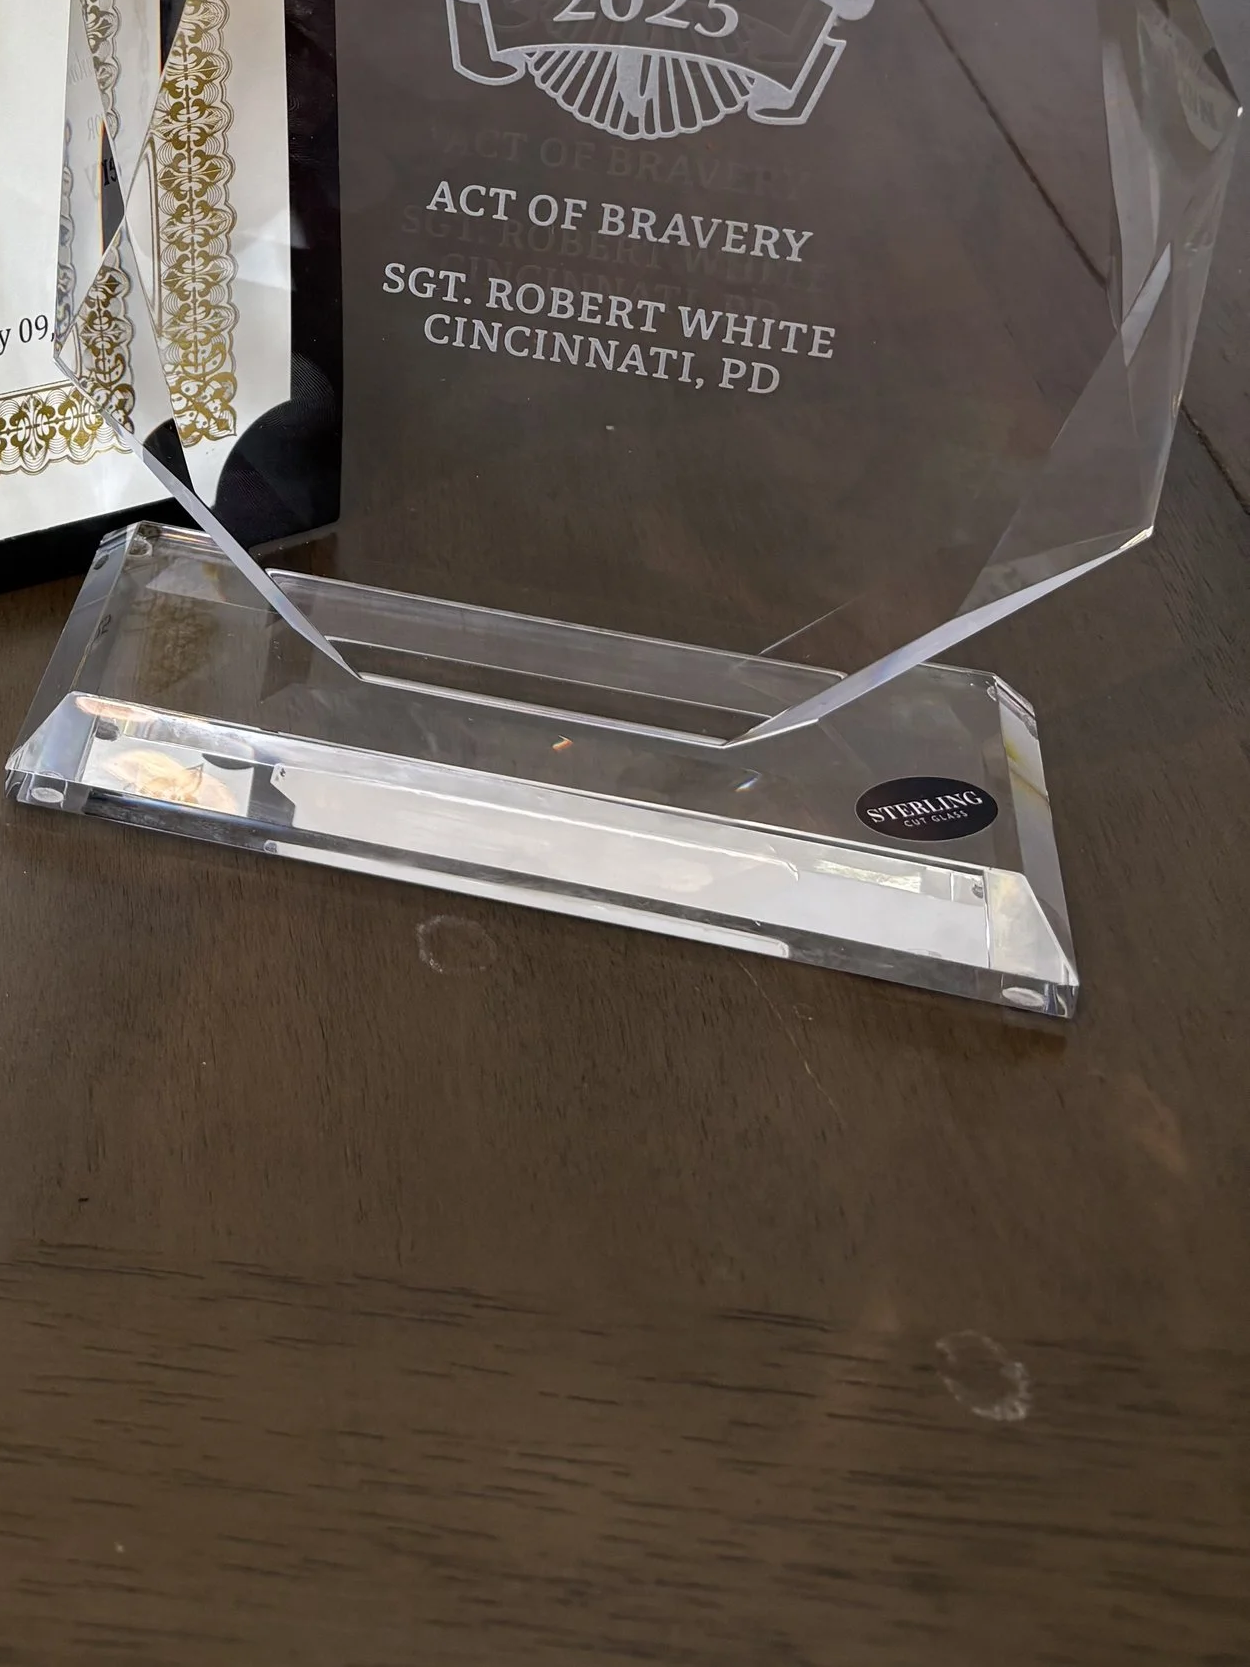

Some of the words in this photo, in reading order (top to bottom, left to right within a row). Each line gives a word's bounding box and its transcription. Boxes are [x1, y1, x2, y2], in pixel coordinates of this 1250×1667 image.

[426, 181, 516, 220] ACT
[528, 195, 587, 230] OF
[598, 203, 813, 262] BRAVERY
[383, 263, 472, 304] SGT.
[486, 278, 665, 333] ROBERT
[678, 306, 835, 358] WHITE
[424, 314, 704, 389] CINCINNATI,
[719, 358, 779, 393] PD
[866, 790, 983, 823] STERLING
[903, 815, 928, 827] CUT
[931, 810, 968, 823] GLASS
